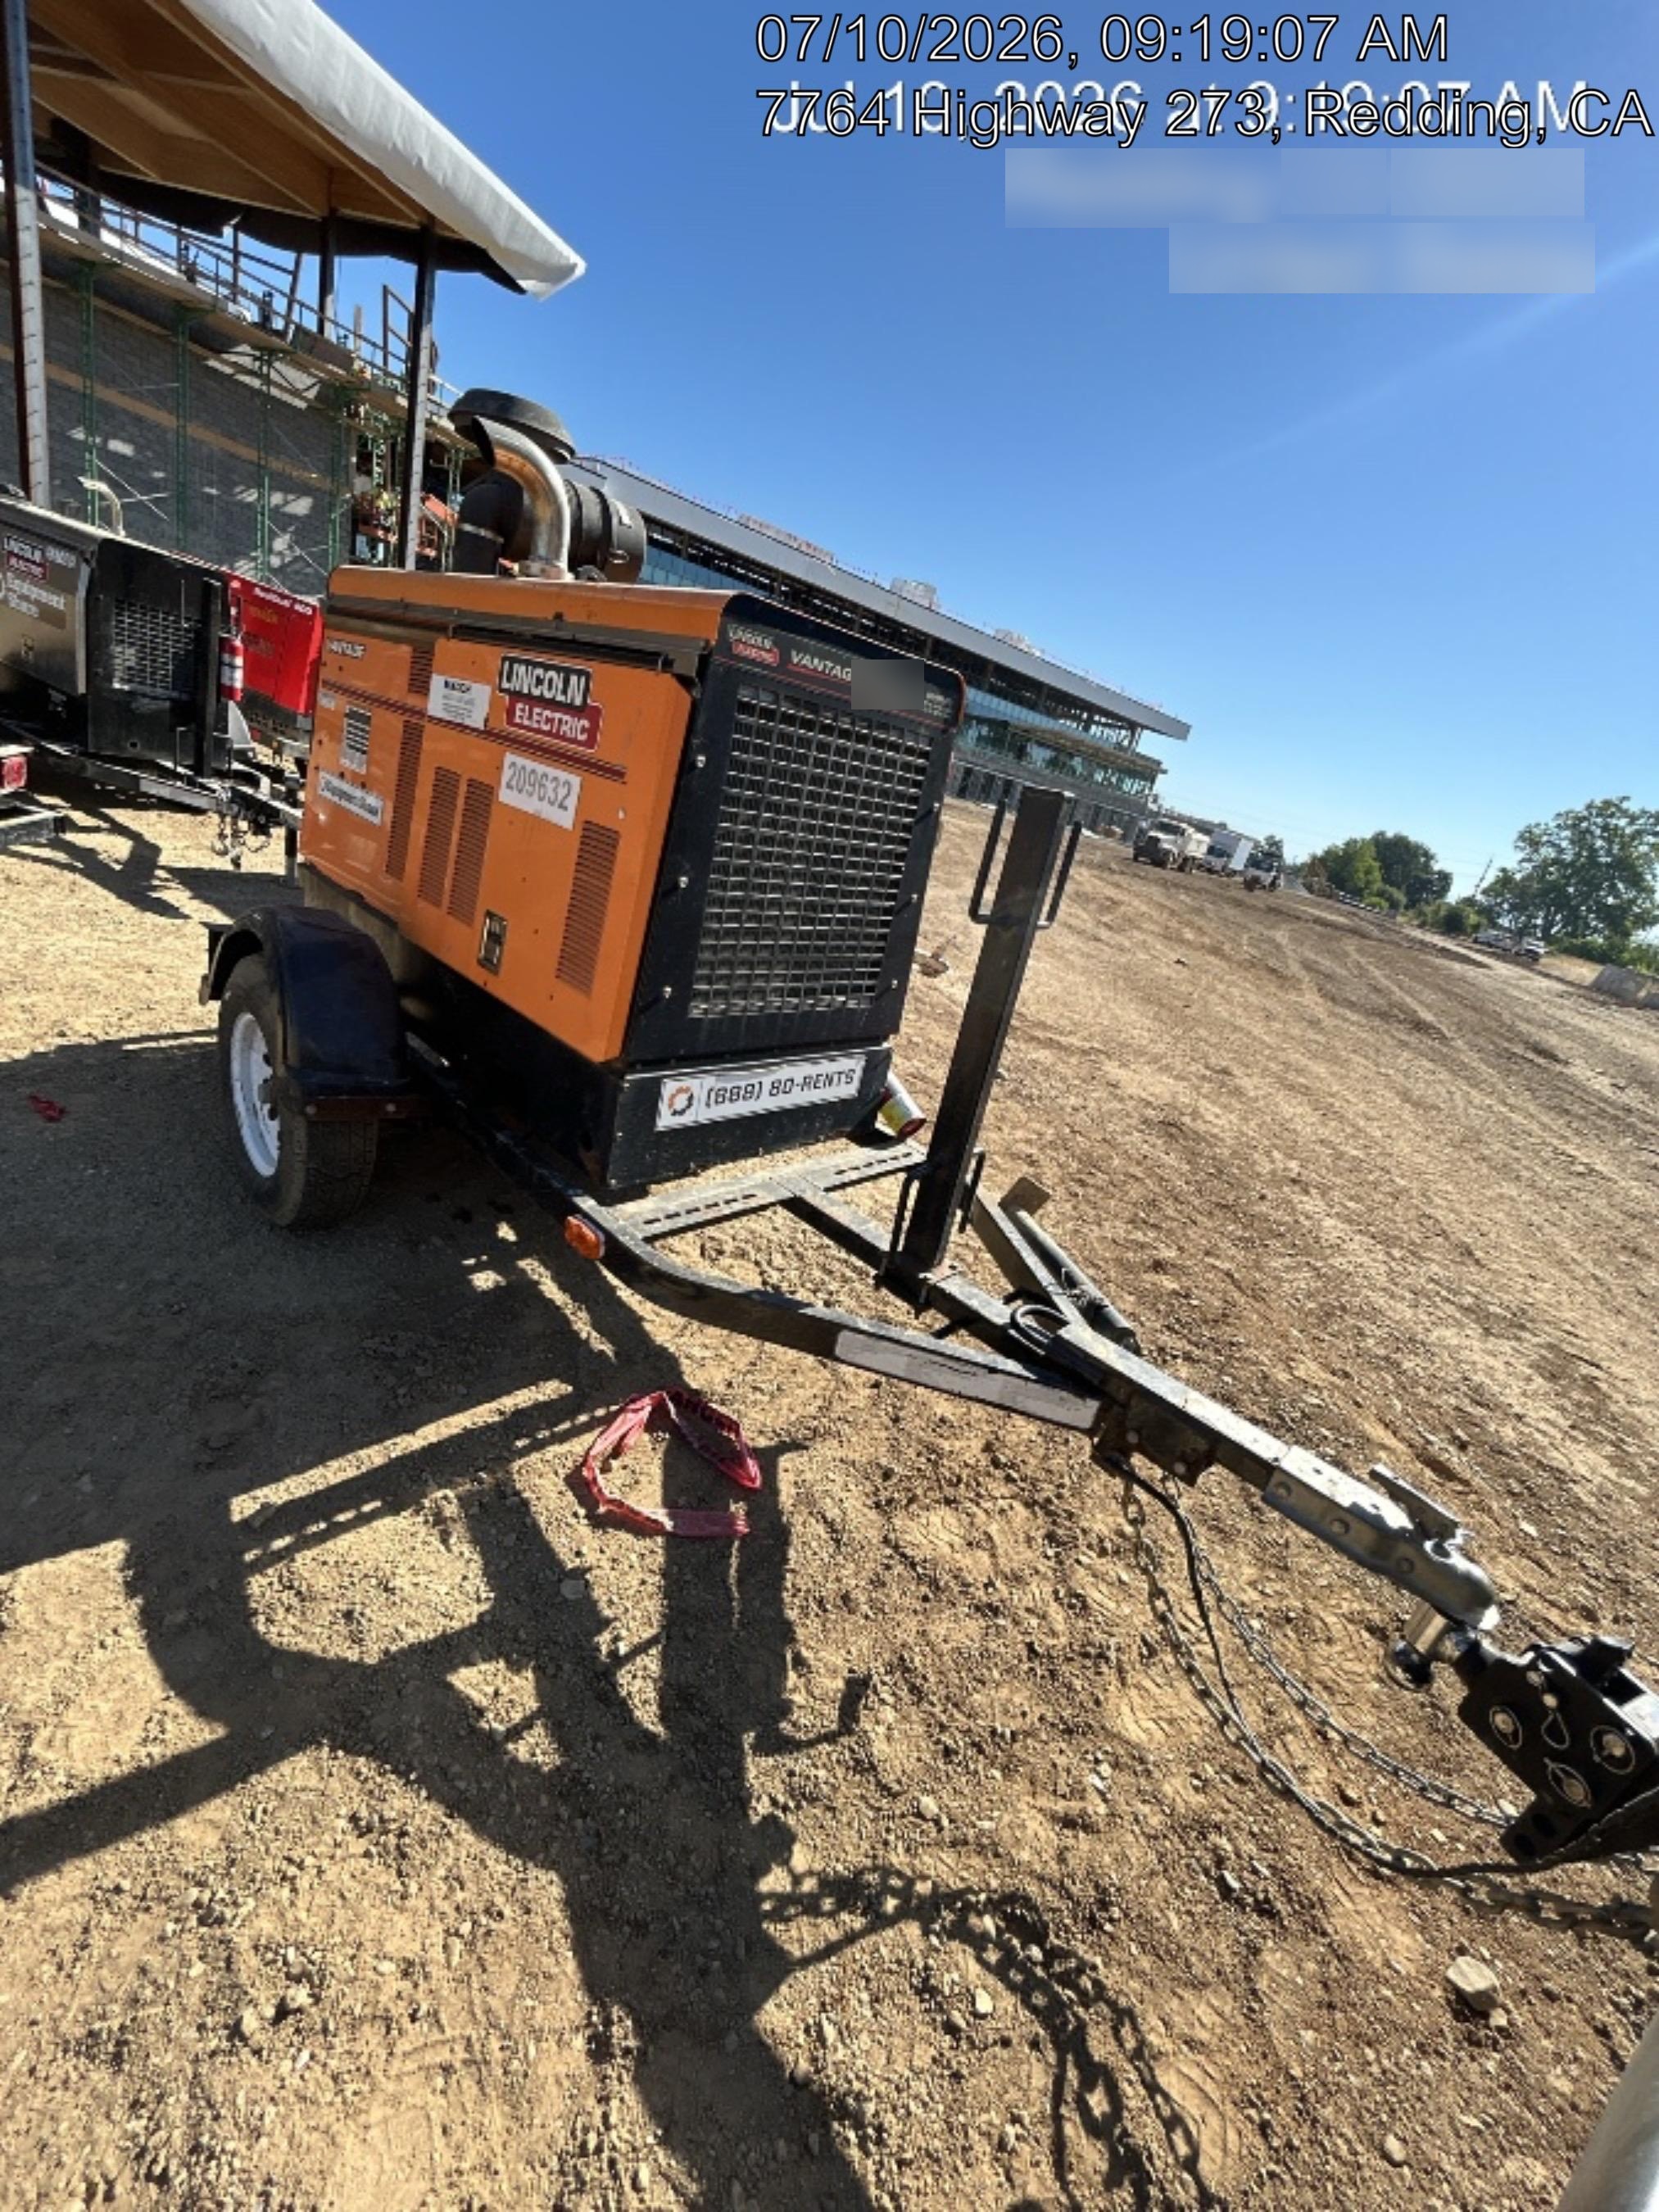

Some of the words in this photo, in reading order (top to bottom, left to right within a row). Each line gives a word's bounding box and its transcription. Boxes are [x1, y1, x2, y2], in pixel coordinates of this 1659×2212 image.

[501, 660, 586, 706] LINCOLN
[791, 649, 851, 682] VANTAG
[513, 702, 590, 741] ELECTRIC
[505, 761, 573, 812] 209632
[768, 1069, 856, 1097] 80-RENTS
